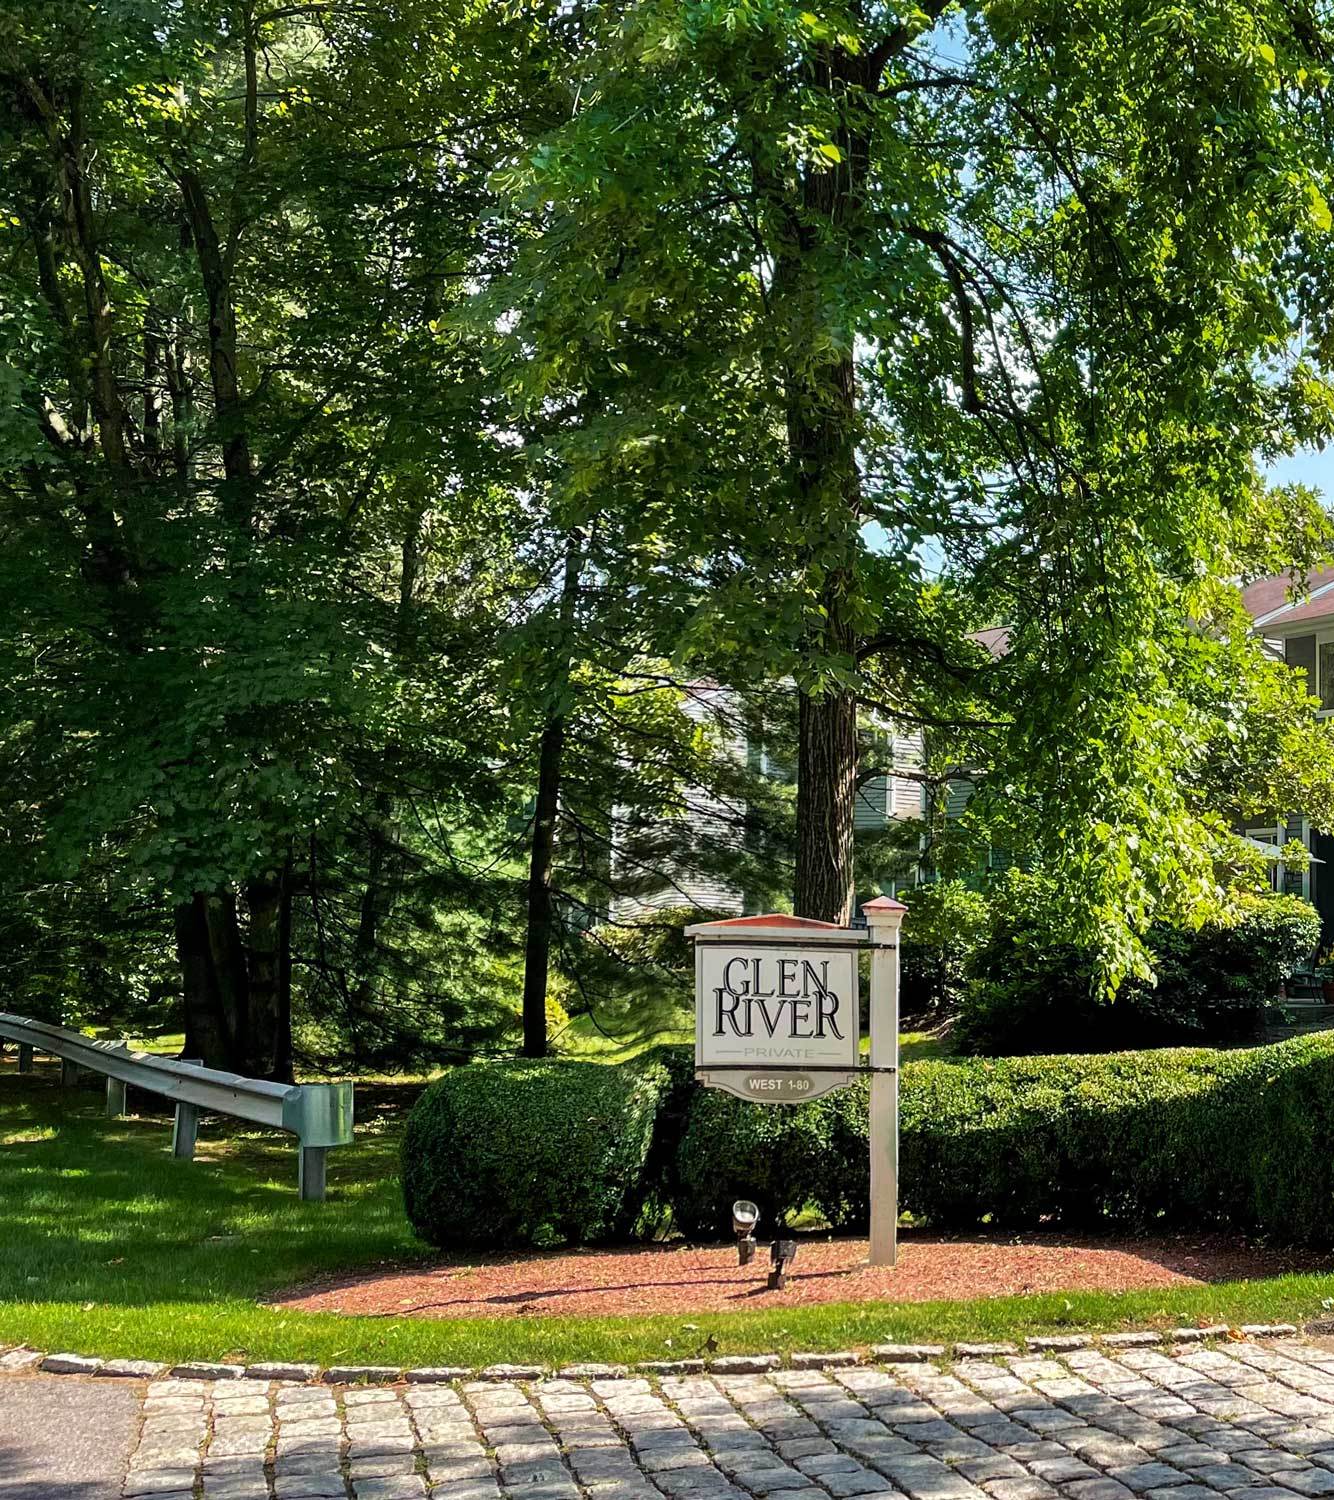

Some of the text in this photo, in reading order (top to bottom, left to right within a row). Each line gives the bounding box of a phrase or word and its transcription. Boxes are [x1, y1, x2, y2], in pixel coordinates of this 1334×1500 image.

[723, 957, 830, 1000] GLEN
[712, 987, 845, 1040] RIVER
[744, 1048, 815, 1058] PRIVATE
[749, 1079, 810, 1091] WEST 1-80
